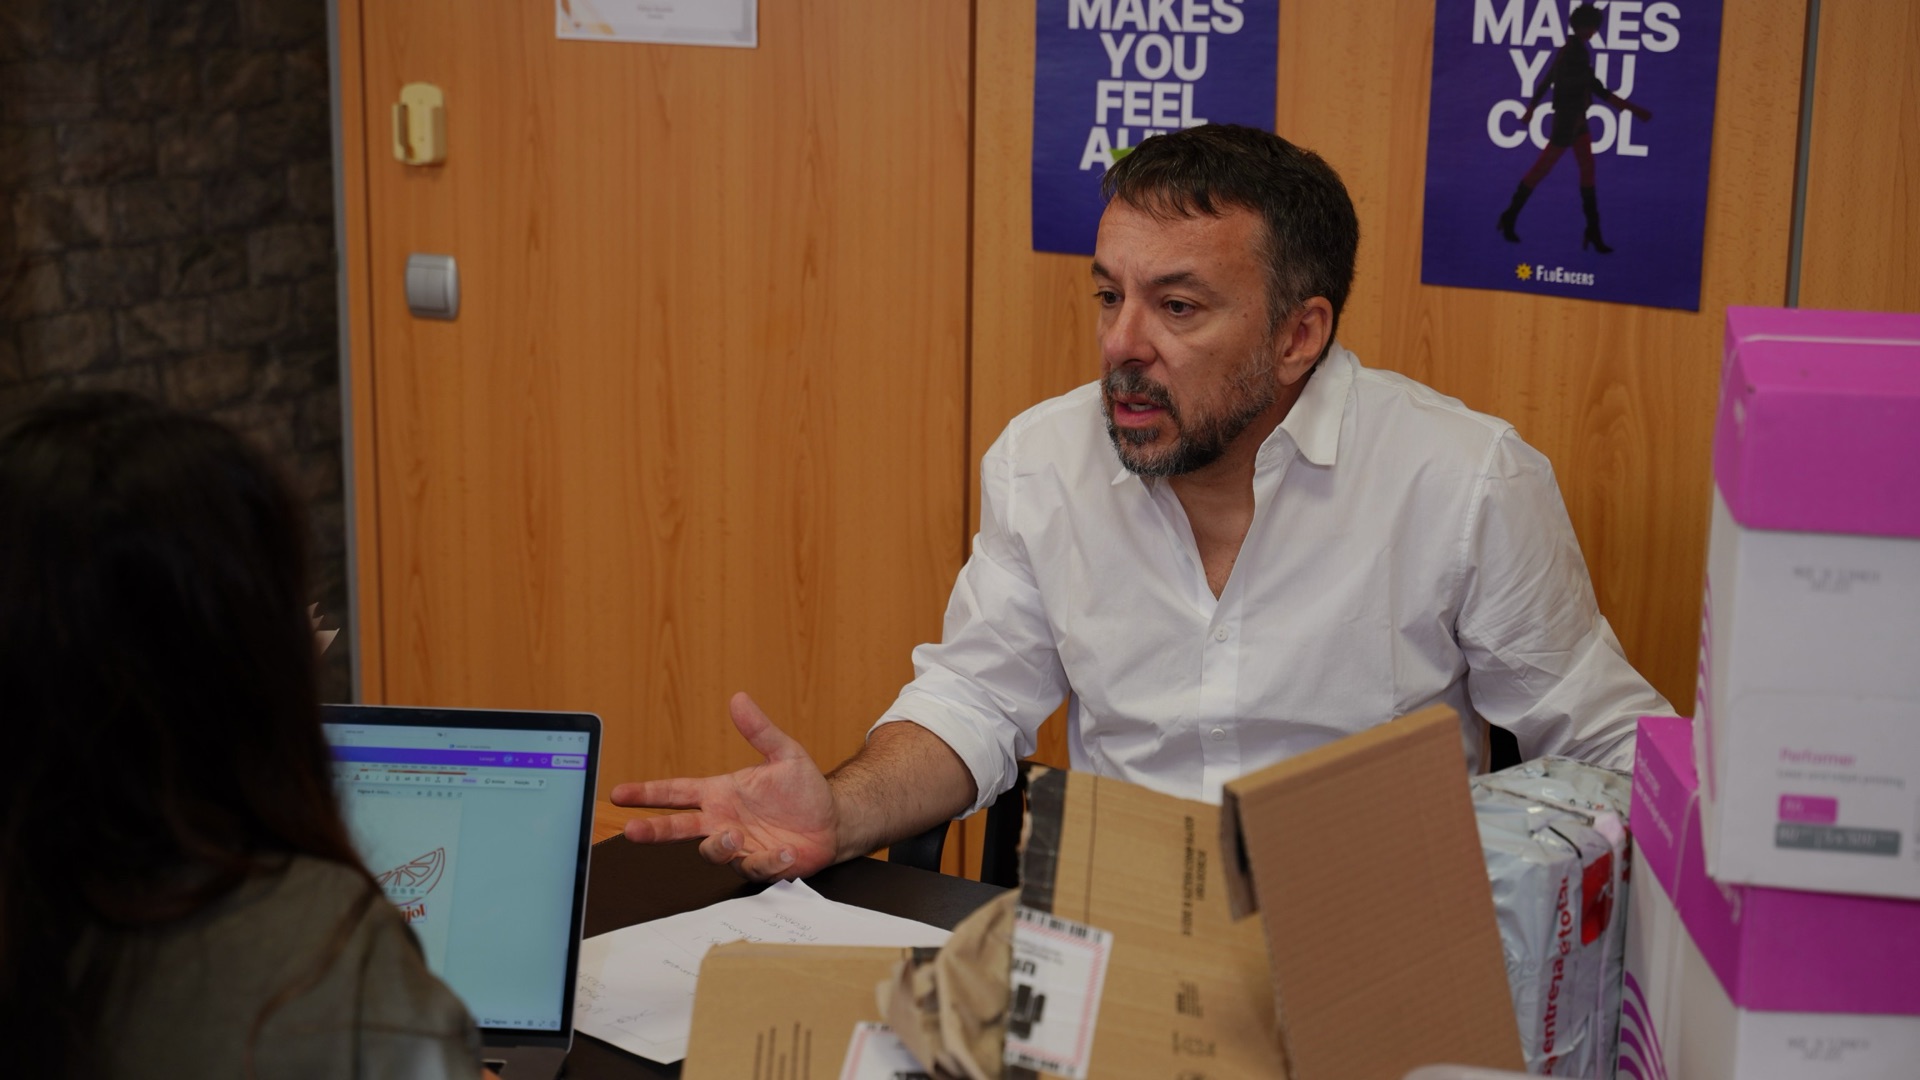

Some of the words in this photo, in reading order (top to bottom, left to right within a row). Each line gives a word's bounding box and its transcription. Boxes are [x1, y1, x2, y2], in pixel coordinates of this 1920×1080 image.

[1068, 0, 1244, 34] MAKES
[1100, 33, 1208, 81] YOU
[1509, 48, 1636, 100] YU
[1096, 80, 1208, 128] FEEL
